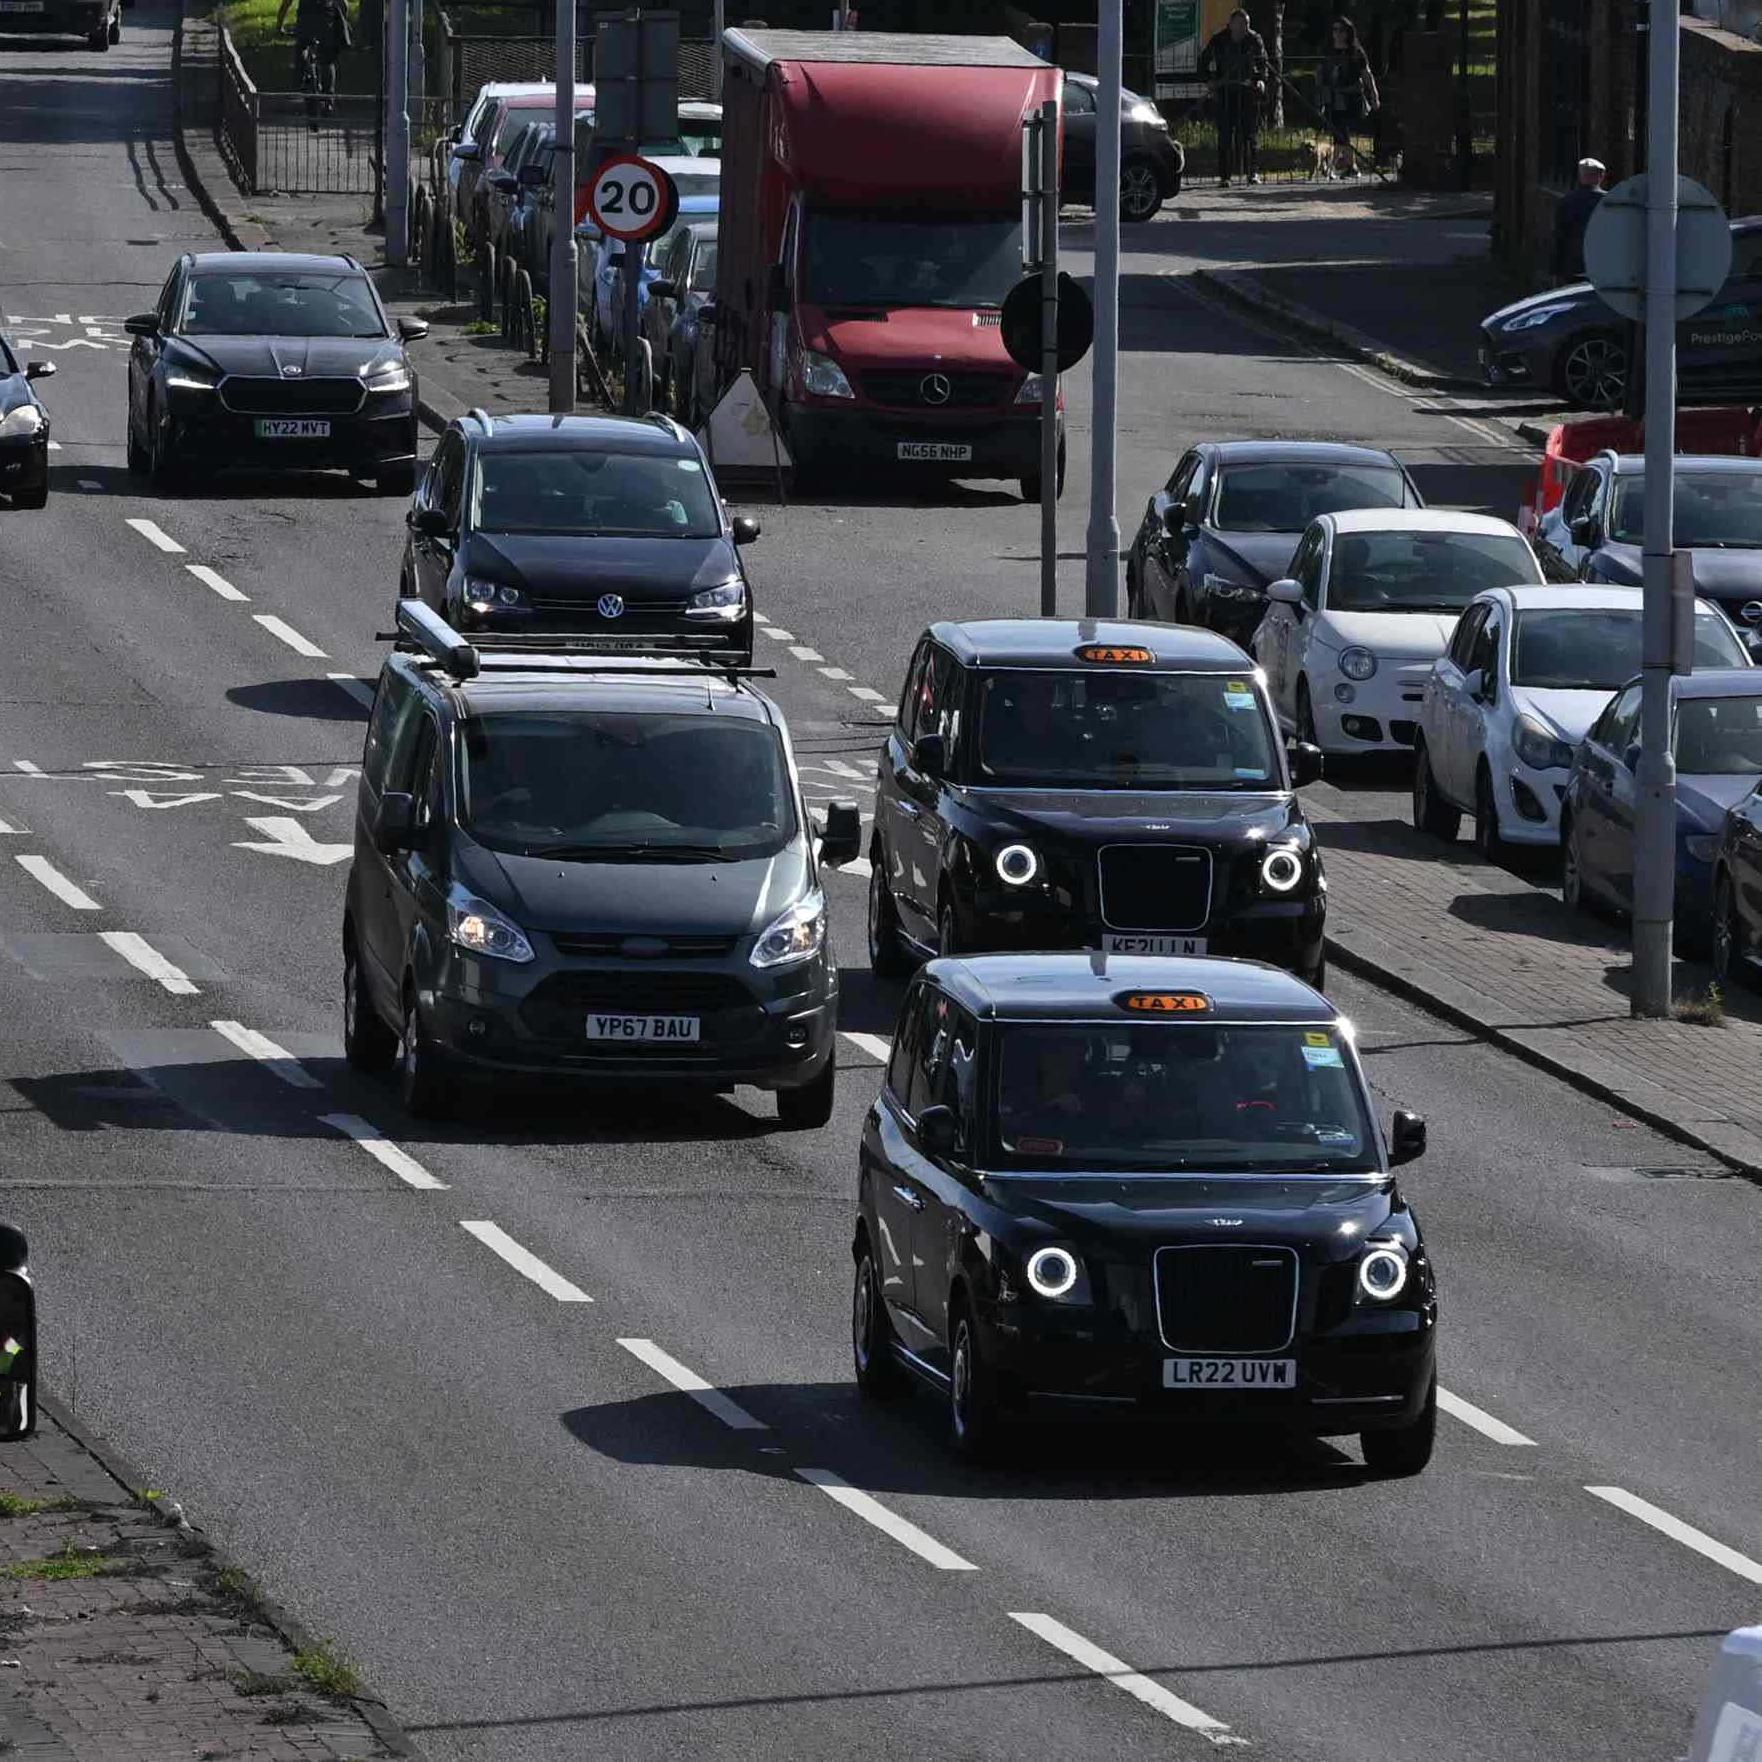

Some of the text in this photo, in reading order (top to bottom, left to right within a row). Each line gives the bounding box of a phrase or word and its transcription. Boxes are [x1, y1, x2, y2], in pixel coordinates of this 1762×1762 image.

[601, 181, 655, 215] 20
[263, 419, 298, 436] HY22
[939, 446, 968, 460] NHP
[1089, 648, 1147, 662] TAXI
[1136, 995, 1201, 1010] TAXI
[596, 1016, 692, 1040] YP67 BAU
[1172, 1361, 1287, 1385] LR22 UVW
